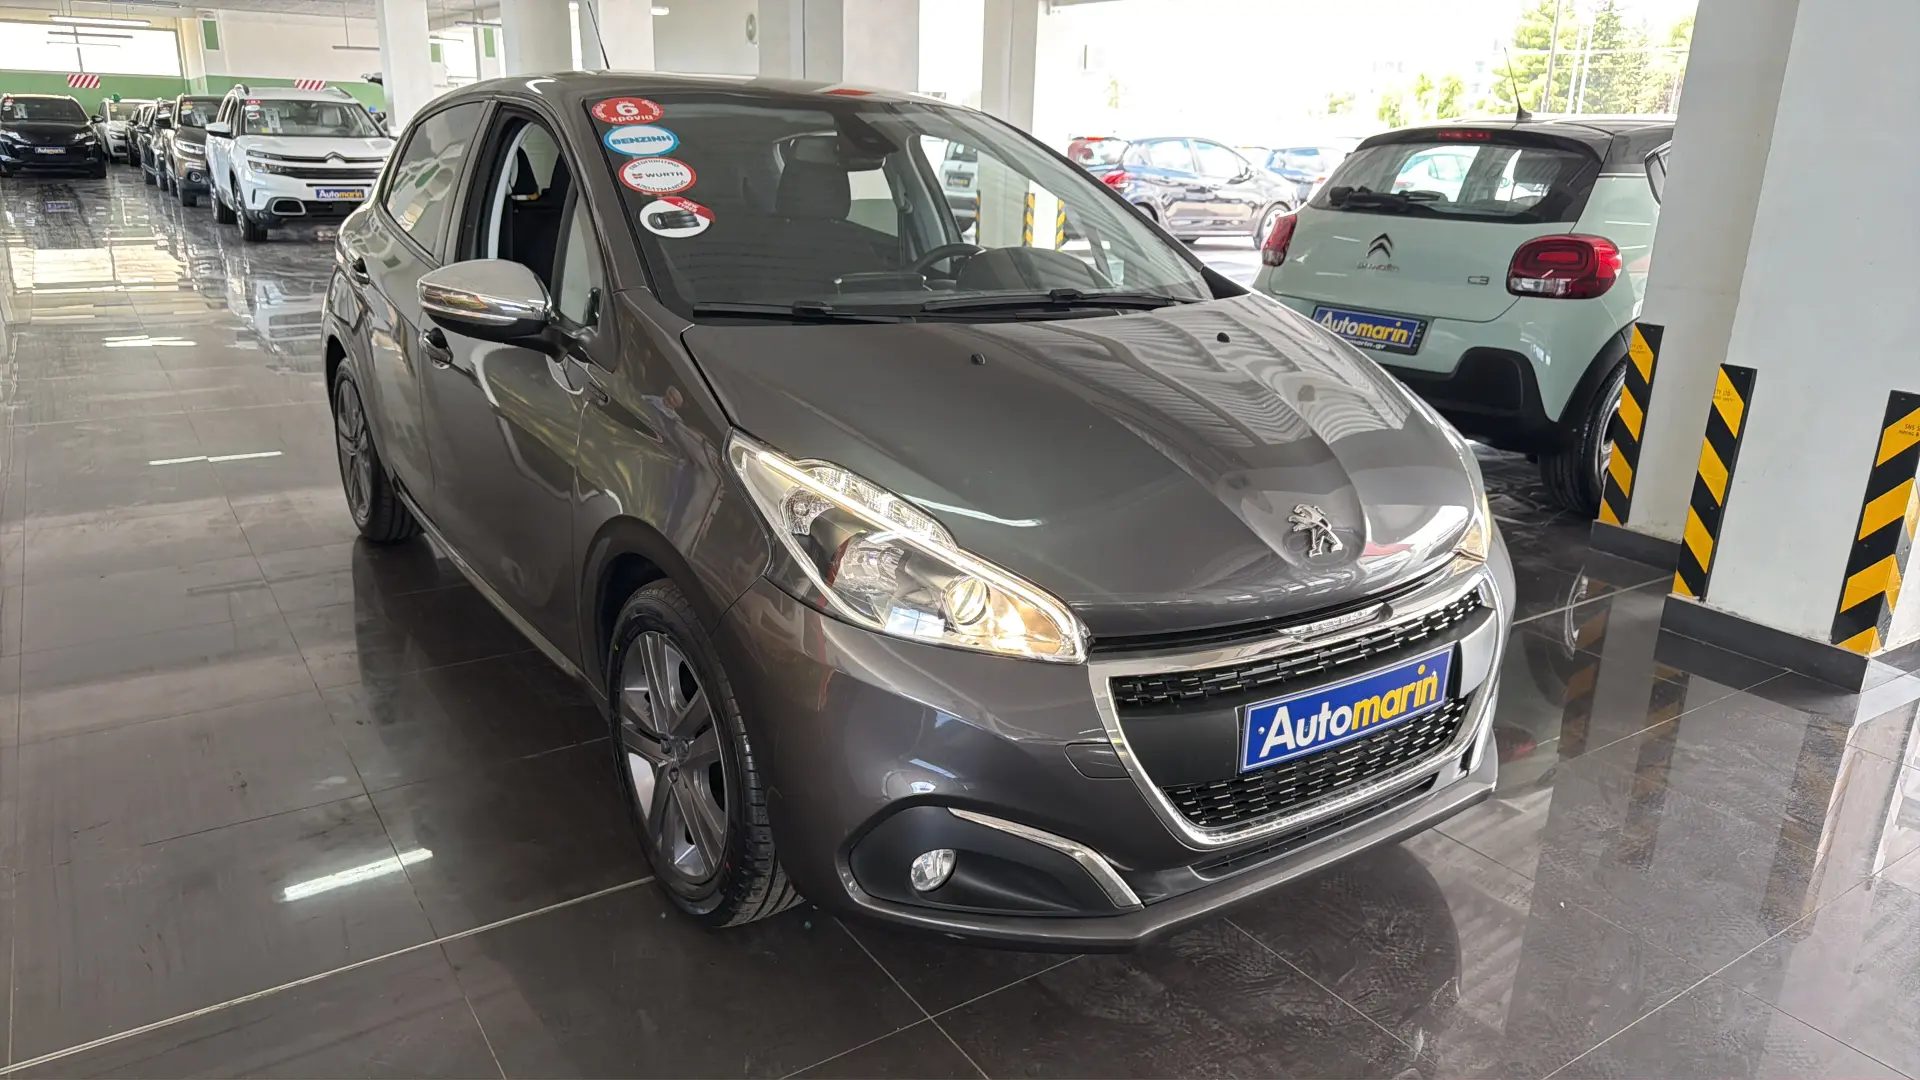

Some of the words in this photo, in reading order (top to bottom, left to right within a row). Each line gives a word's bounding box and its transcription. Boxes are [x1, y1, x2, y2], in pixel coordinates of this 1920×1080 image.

[616, 103, 639, 116] 6
[1320, 311, 1409, 344] Automarin
[1258, 664, 1438, 758] Automarin
